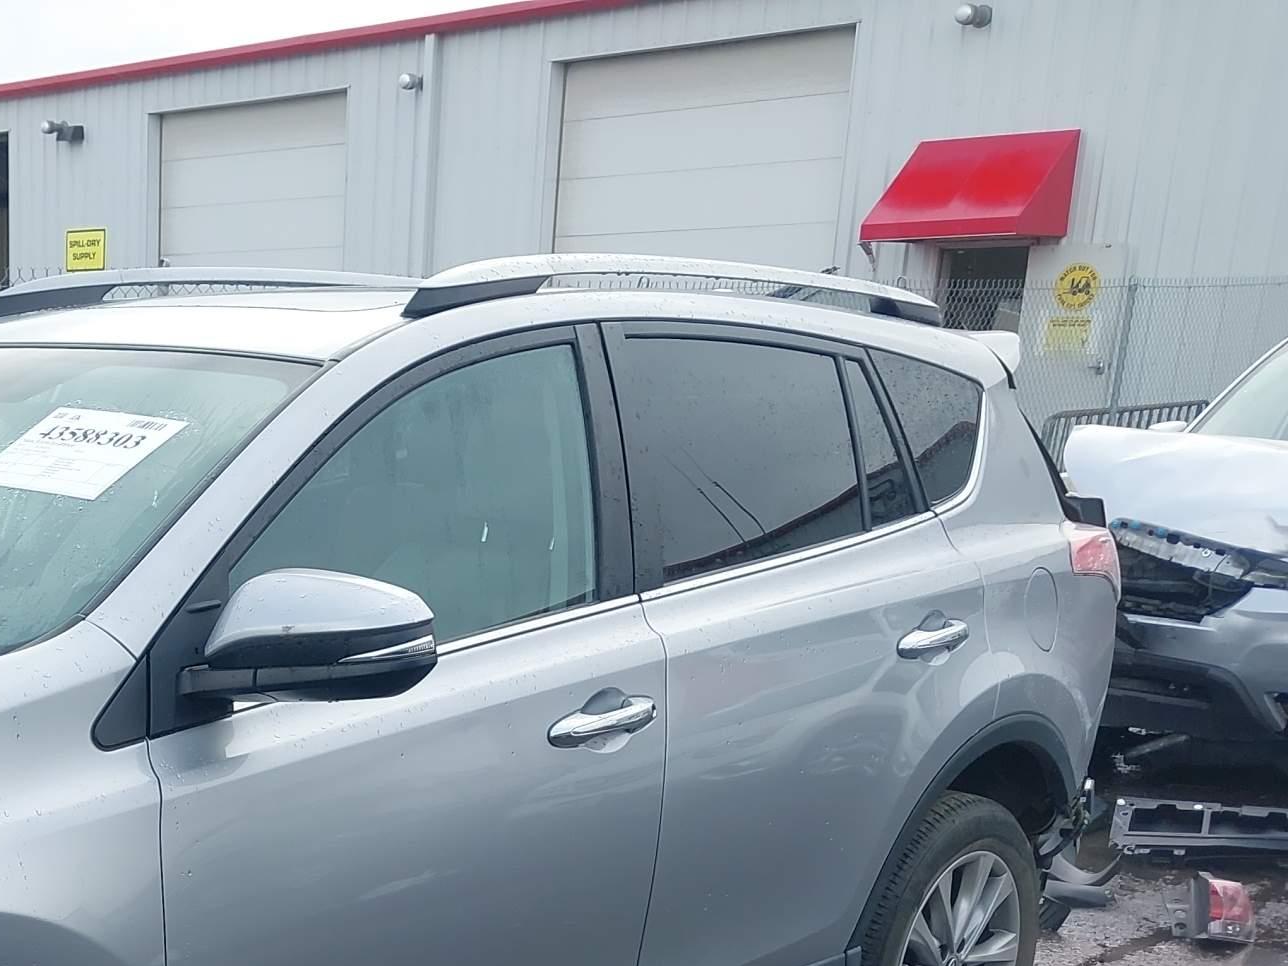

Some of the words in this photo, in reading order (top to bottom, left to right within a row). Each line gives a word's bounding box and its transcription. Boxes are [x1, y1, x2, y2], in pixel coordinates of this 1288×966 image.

[69, 239, 101, 249] SPILL-DRY
[72, 252, 97, 261] SUPPLY
[38, 424, 147, 450] 43588303
